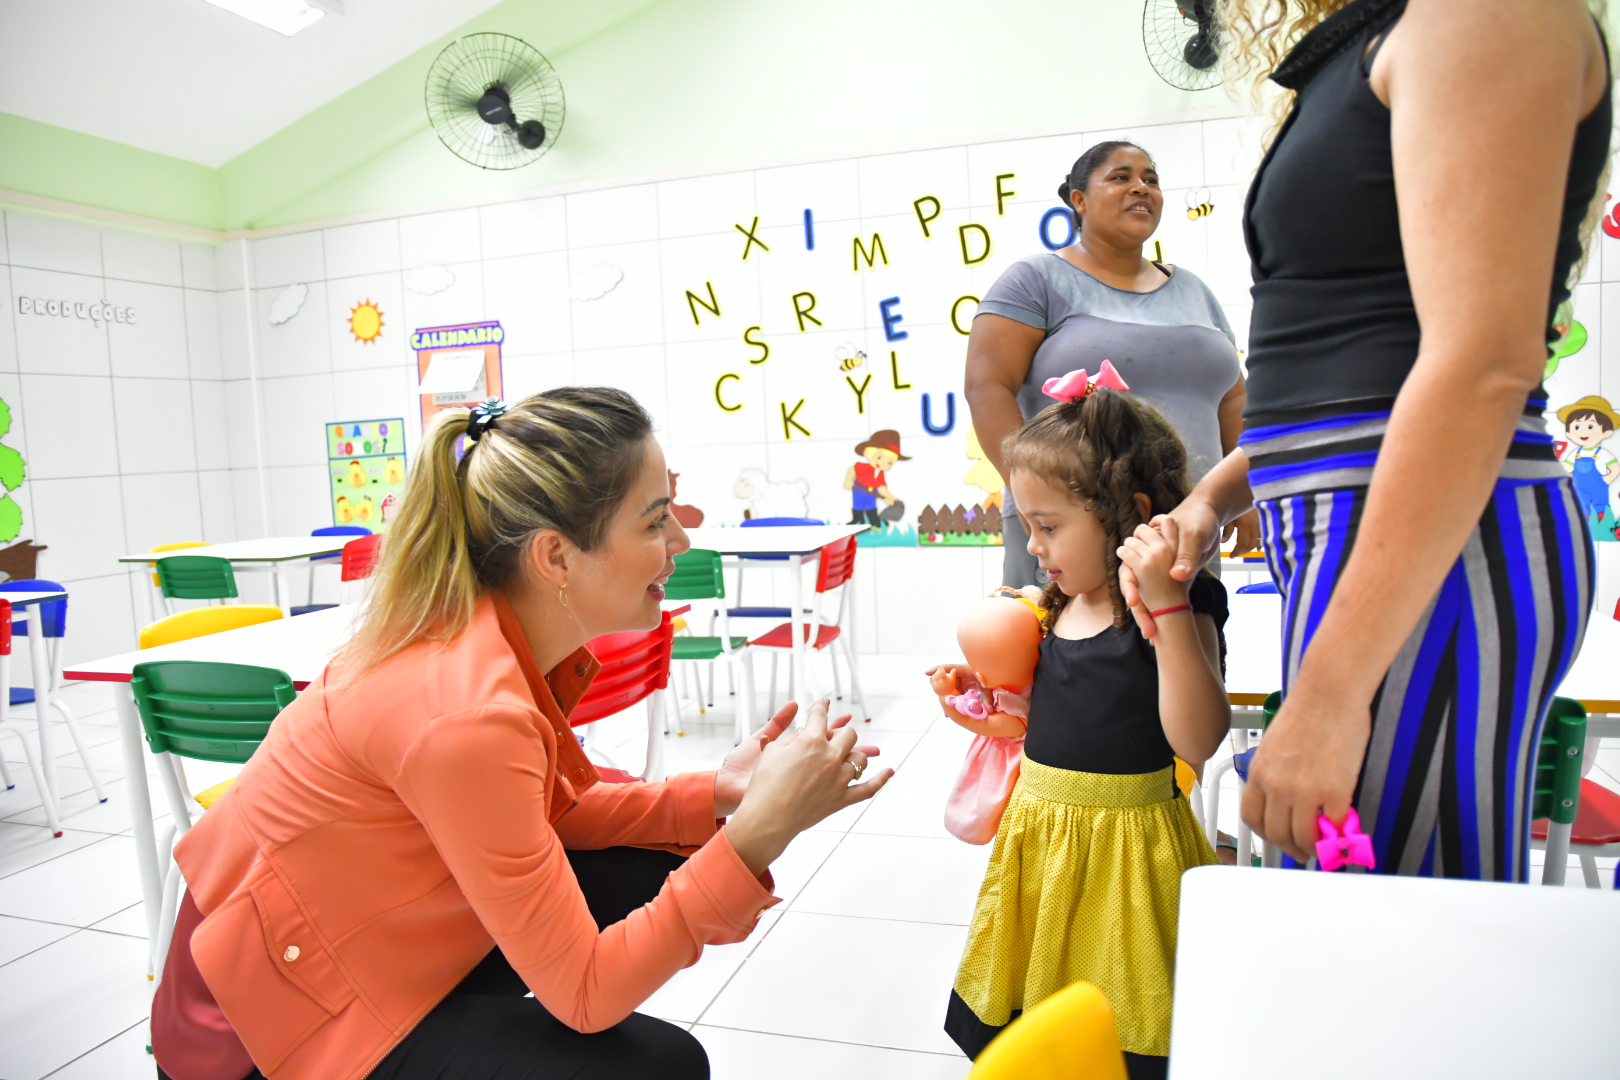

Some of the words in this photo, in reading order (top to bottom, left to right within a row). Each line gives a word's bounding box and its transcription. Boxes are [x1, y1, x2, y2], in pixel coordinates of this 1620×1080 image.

[996, 173, 1016, 216] F
[735, 216, 770, 260] X
[803, 208, 815, 251] I
[912, 195, 942, 238] P
[1039, 206, 1077, 252] O
[853, 232, 889, 272] M
[958, 223, 992, 266] D
[18, 296, 138, 328] PRODUÇÕES
[685, 281, 721, 326] N
[792, 291, 823, 333] R
[878, 296, 909, 343] E
[743, 326, 770, 365] S
[891, 350, 912, 390] L
[714, 373, 744, 413] C
[845, 374, 873, 415] Y
[922, 392, 955, 437] U
[780, 398, 812, 441] K
[337, 438, 388, 455] SOOS?
